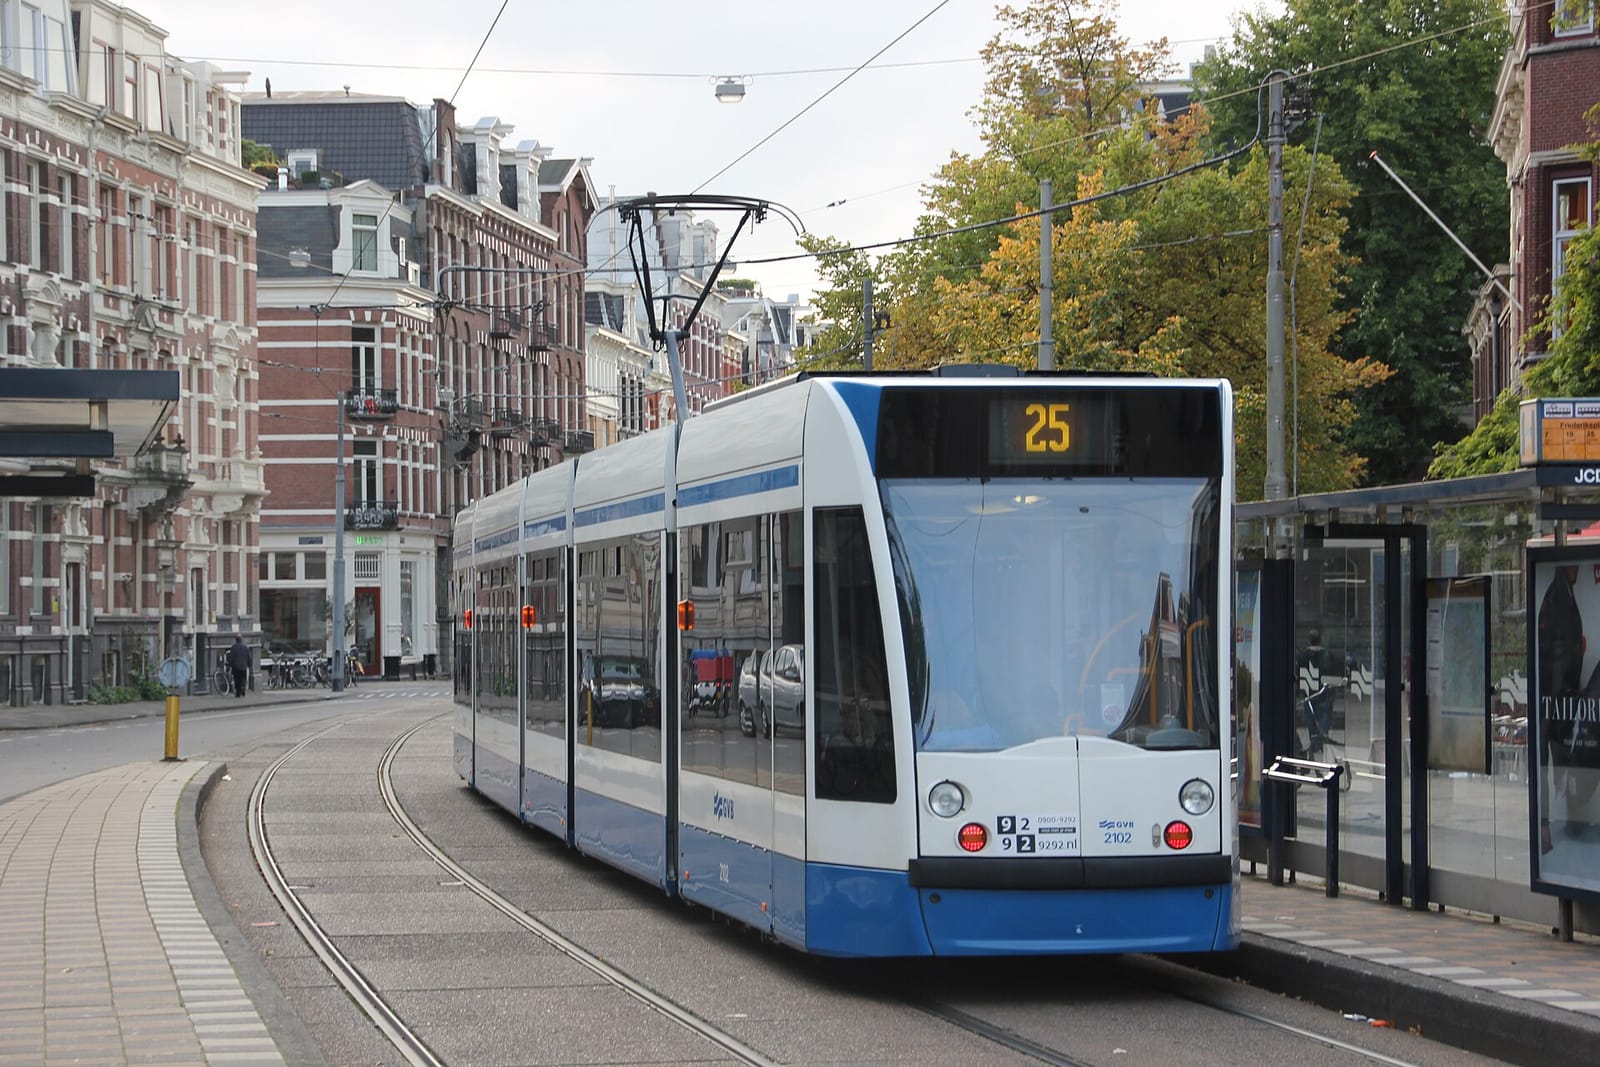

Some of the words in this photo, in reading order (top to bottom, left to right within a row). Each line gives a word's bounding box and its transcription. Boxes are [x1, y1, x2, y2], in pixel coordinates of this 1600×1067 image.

[1026, 404, 1069, 452] 25
[1542, 696, 1600, 722] TAILOR
[723, 797, 734, 820] GVB
[1104, 832, 1132, 844] 2102
